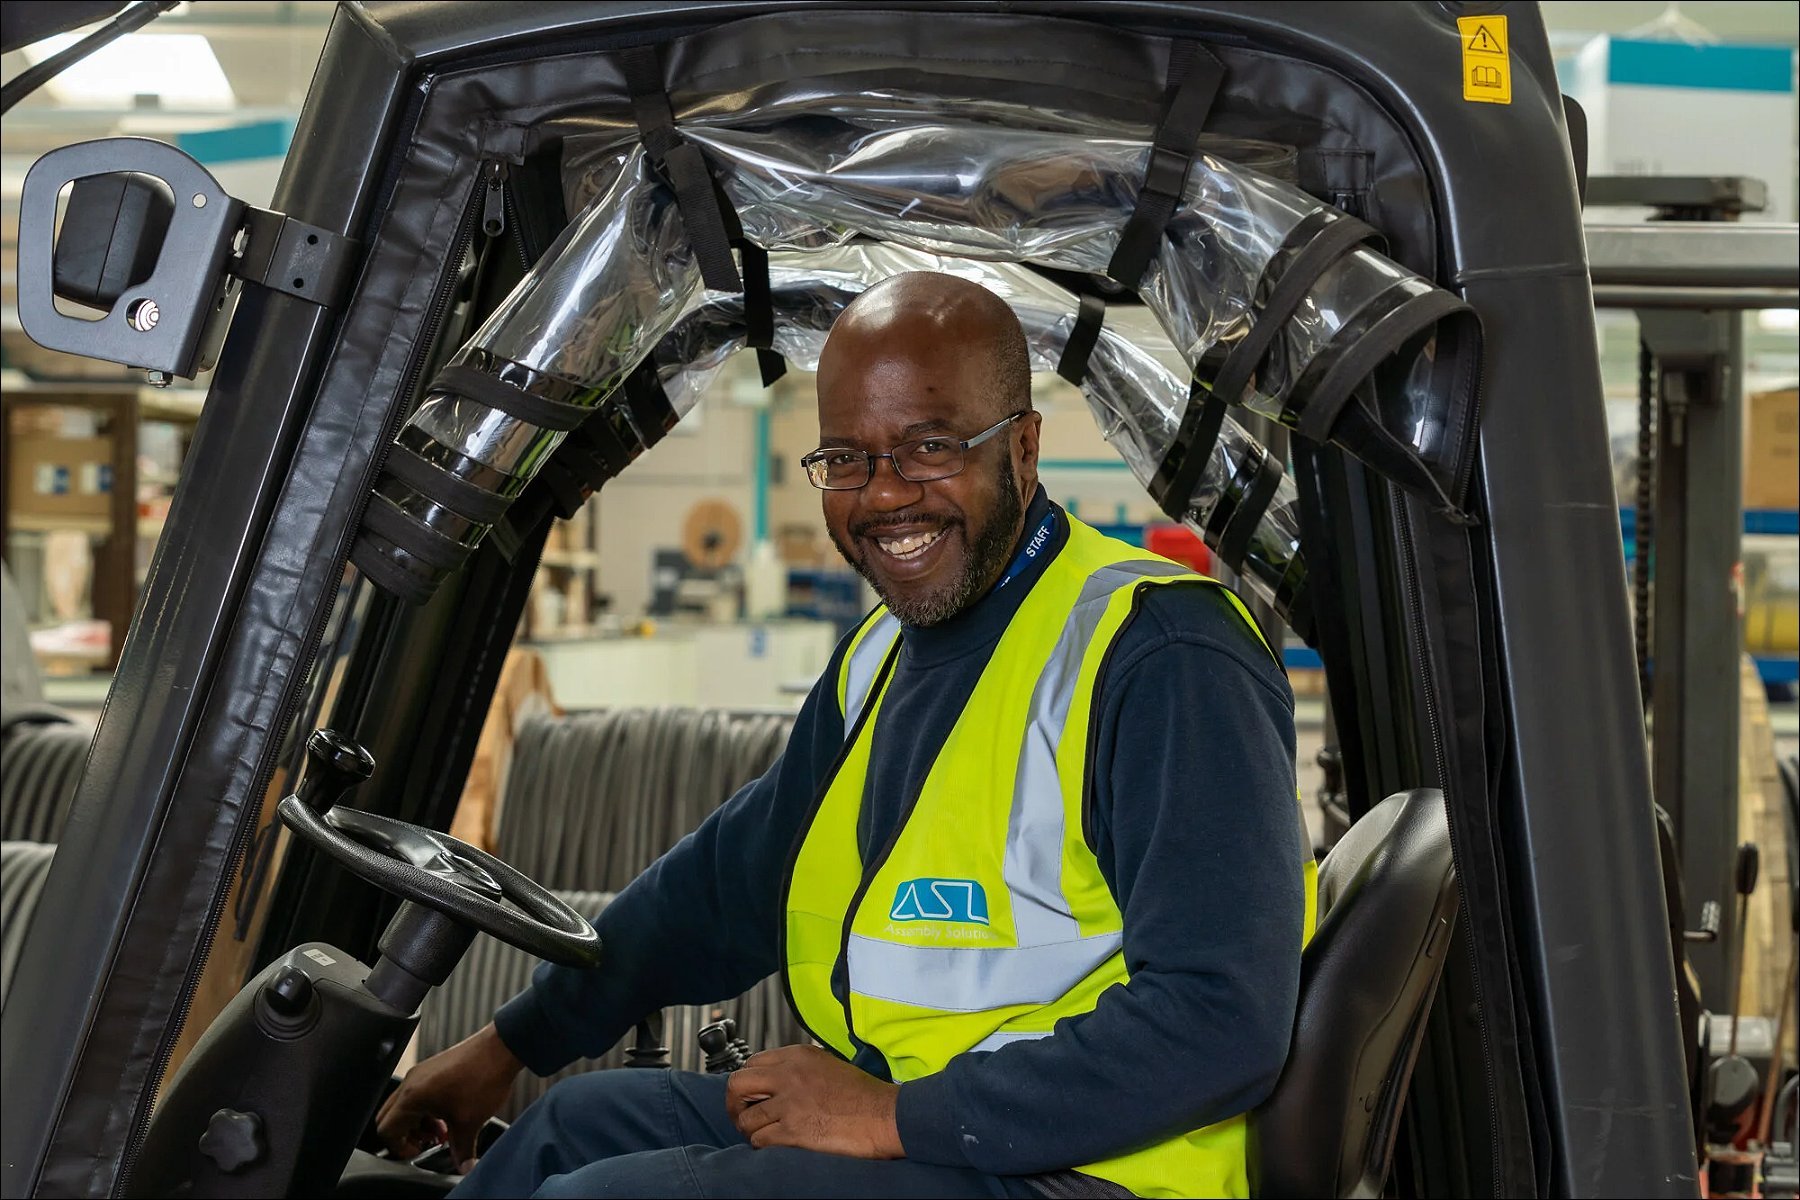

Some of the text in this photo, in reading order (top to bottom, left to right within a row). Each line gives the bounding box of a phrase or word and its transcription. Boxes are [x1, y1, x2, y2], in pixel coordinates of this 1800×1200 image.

[1026, 525, 1050, 557] STAFF
[891, 881, 989, 924] ASL
[884, 923, 998, 940] Assembly Solutio
